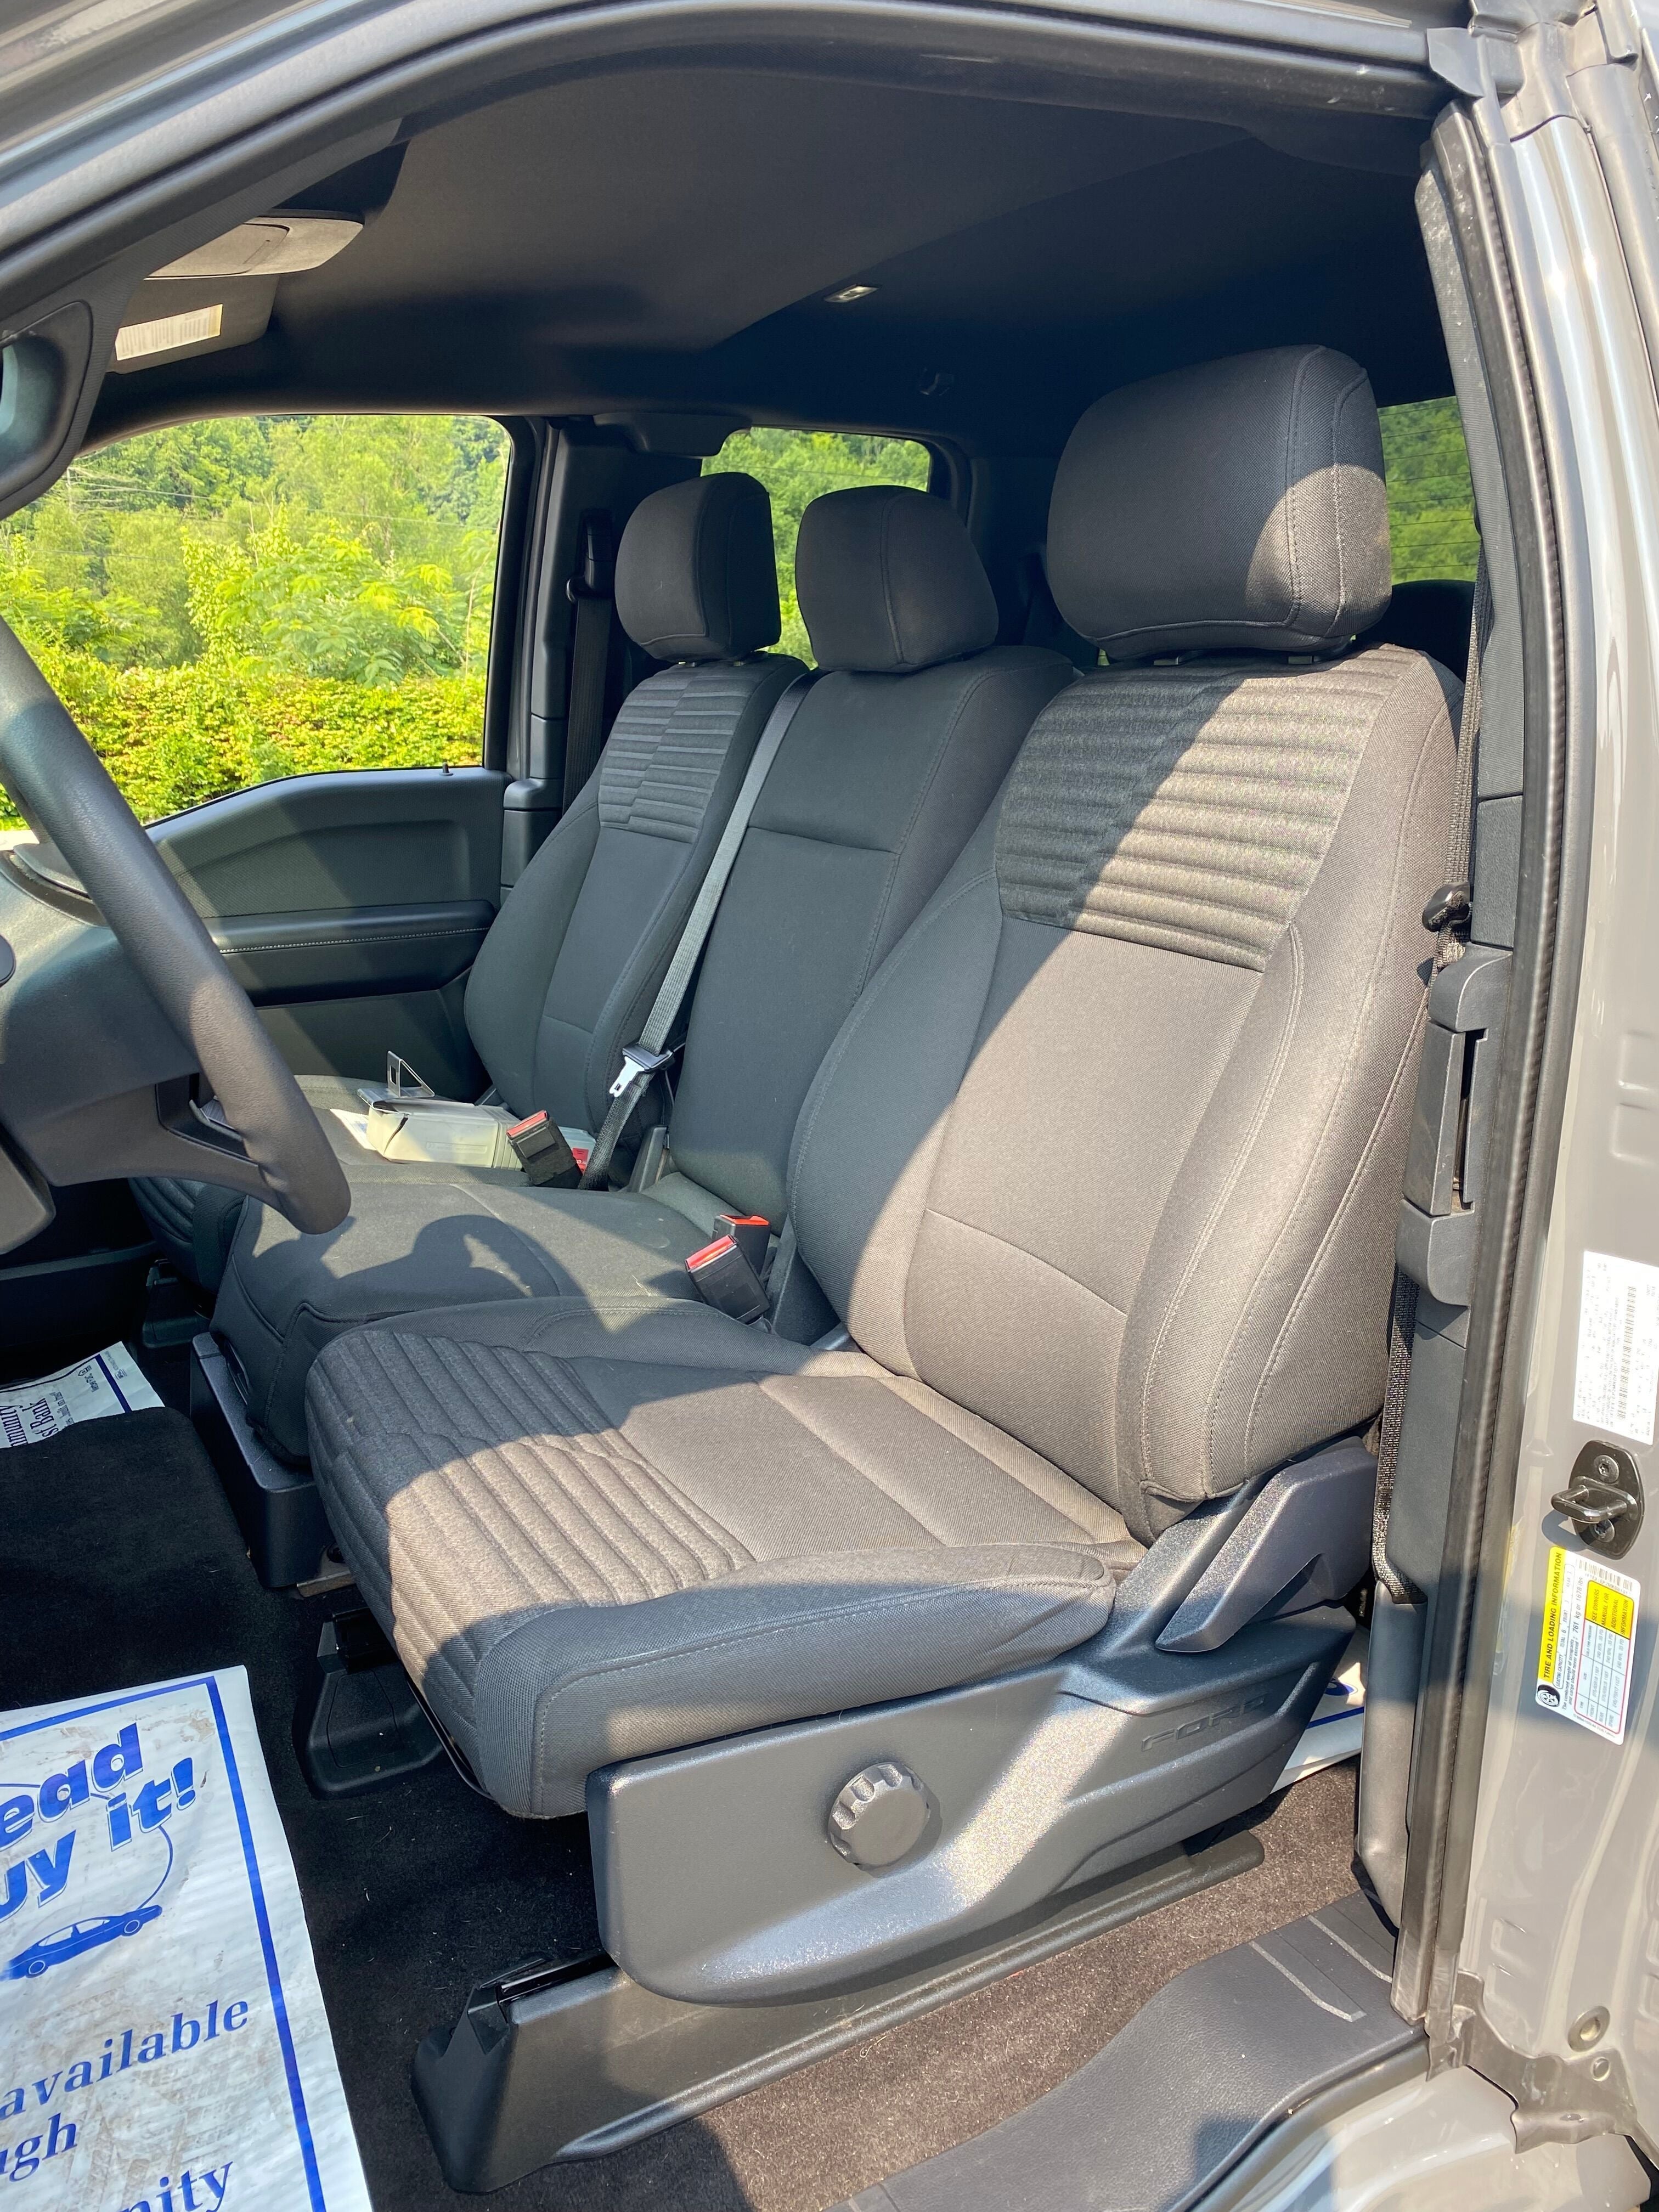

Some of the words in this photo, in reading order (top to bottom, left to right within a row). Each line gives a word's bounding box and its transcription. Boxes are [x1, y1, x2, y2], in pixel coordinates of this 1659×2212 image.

[22, 1398, 54, 1430] Bank
[1550, 1551, 1562, 1606] INFORMATION
[1547, 1606, 1556, 1642] LOADING
[1573, 1610, 1581, 1620] kg
[1610, 1598, 1619, 1629] ADDITIONAL
[1620, 1598, 1629, 1635] INFORMATION
[1545, 1641, 1553, 1660] AND
[1543, 1660, 1551, 1680] TIRE
[1141, 1692, 1269, 1752] FORD
[106, 1757, 196, 1852] it!
[0, 2000, 249, 2121] available
